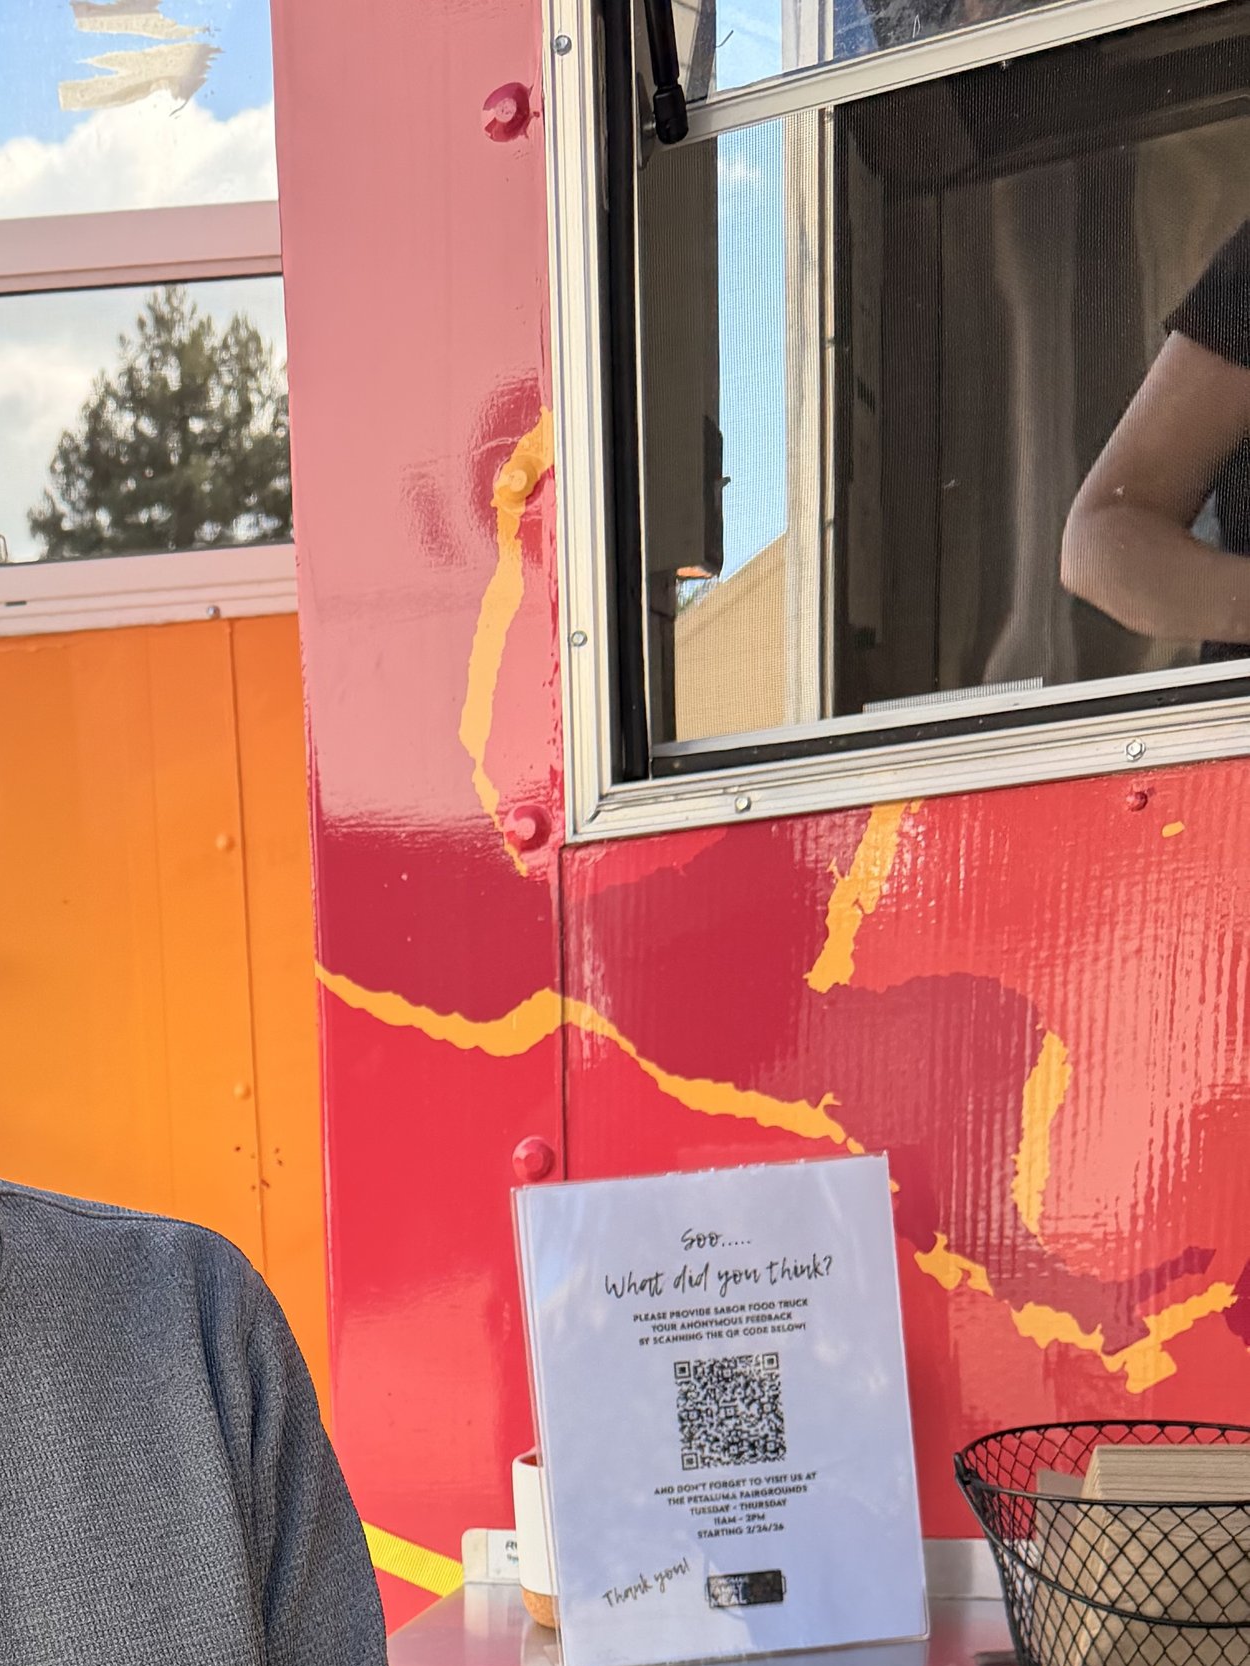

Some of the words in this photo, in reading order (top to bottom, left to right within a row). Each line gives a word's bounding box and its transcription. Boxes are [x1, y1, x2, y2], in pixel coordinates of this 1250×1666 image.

[605, 1271, 664, 1299] What
[673, 1262, 710, 1294] did
[717, 1266, 760, 1298] you
[765, 1252, 834, 1286] think?
[633, 1311, 668, 1323] PLEASE
[669, 1307, 712, 1320] PROVIDE
[714, 1304, 746, 1317] SABOR
[748, 1301, 776, 1314] FOOD
[778, 1298, 809, 1311] TRUCK
[651, 1321, 678, 1333] YOUR
[680, 1316, 743, 1331] ANONYMOUS
[745, 1311, 793, 1325] FEEDBACK
[638, 1336, 650, 1346] BY
[652, 1330, 704, 1345] SCANNING
[706, 1329, 724, 1340] THE
[726, 1327, 741, 1339] QR
[743, 1324, 769, 1336] CODE
[653, 1486, 674, 1496] AND
[677, 1483, 707, 1494] DON'T
[709, 1479, 746, 1491] FORGET
[749, 1477, 762, 1487] TO
[764, 1474, 788, 1485] VISIT
[790, 1472, 803, 1483] US
[805, 1471, 818, 1481] AT
[667, 1497, 686, 1507] THE
[687, 1492, 738, 1505] PETALUMA
[739, 1484, 808, 1499] FAIRGROUNDS
[690, 1504, 731, 1516] TUESDAY
[740, 1498, 787, 1512] THURSDAY
[714, 1516, 737, 1526] 11AM
[745, 1512, 766, 1522] 2PM
[697, 1527, 743, 1539] STARTING
[602, 1573, 653, 1607] Thank
[654, 1557, 690, 1593] you!
